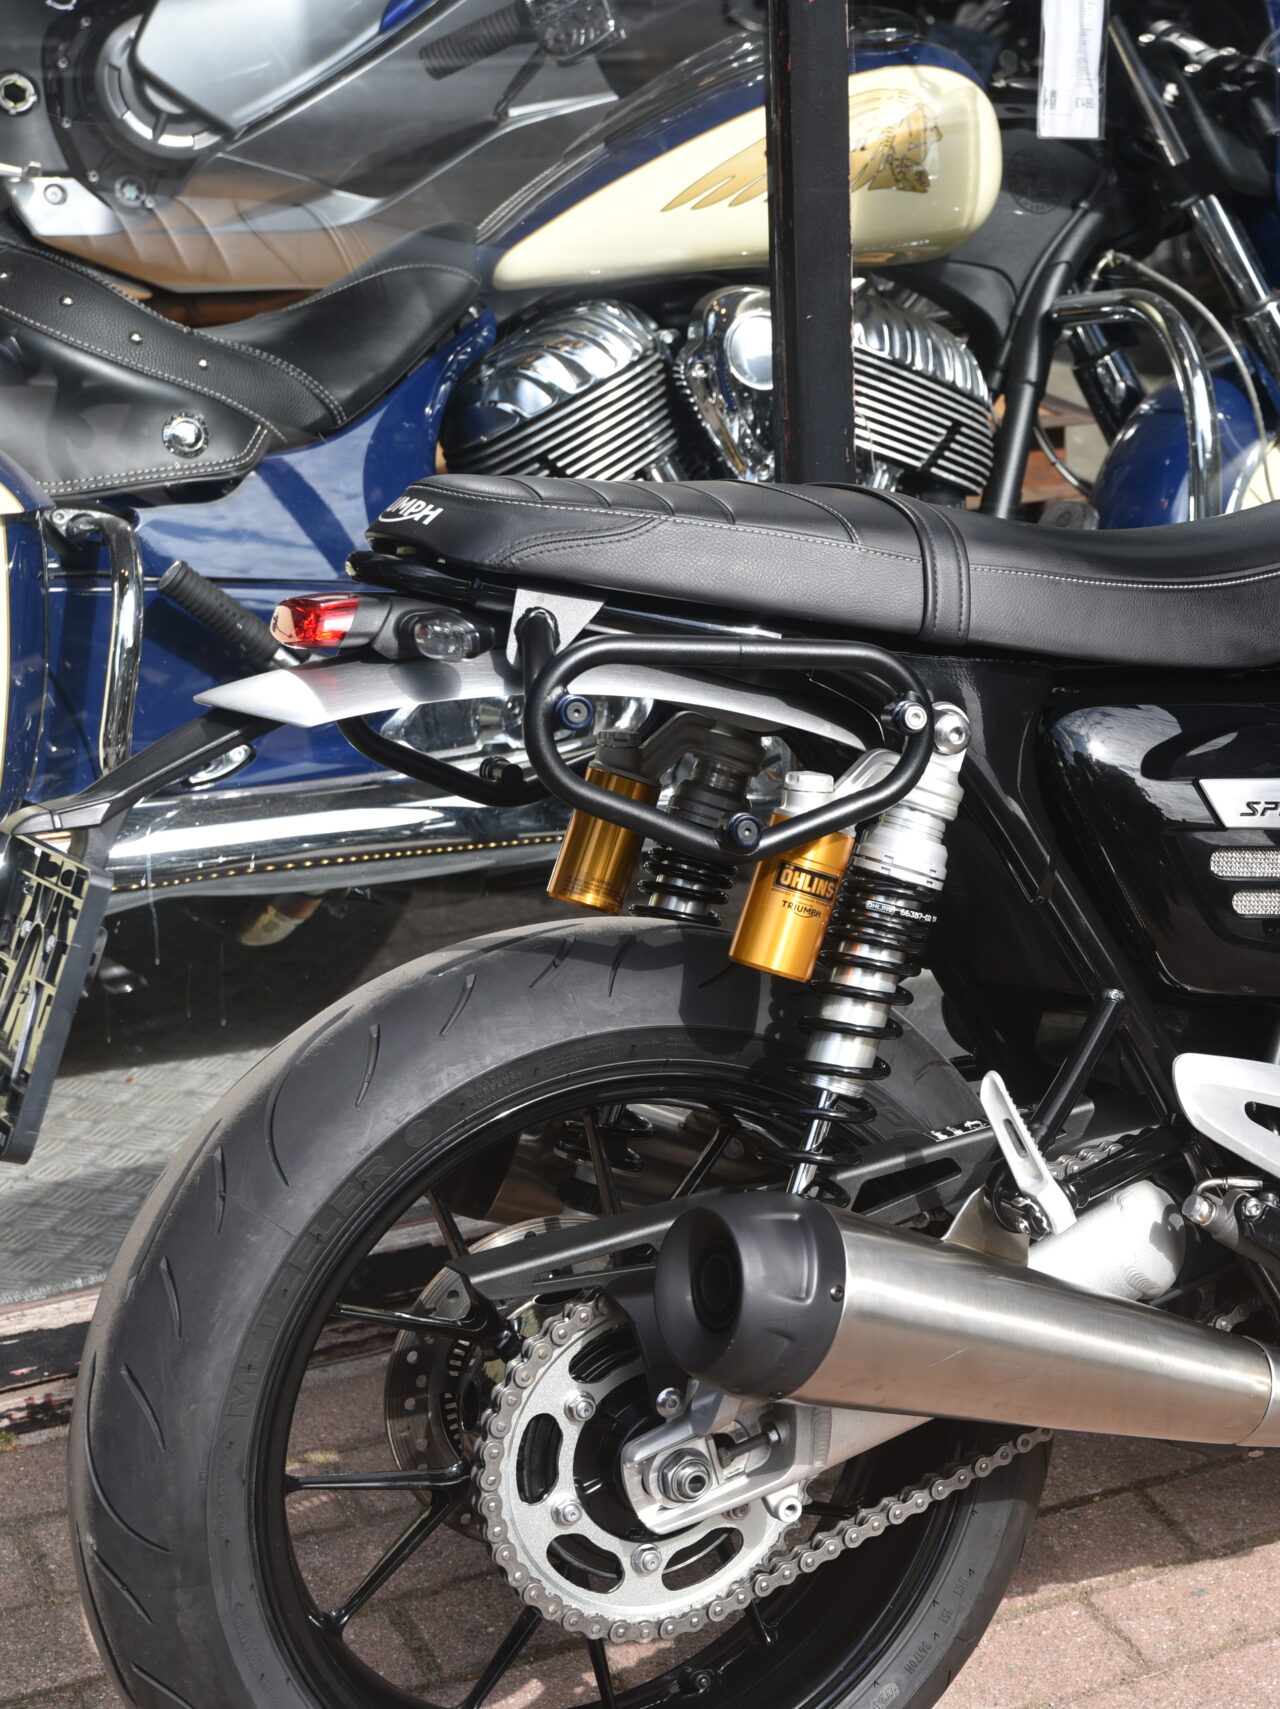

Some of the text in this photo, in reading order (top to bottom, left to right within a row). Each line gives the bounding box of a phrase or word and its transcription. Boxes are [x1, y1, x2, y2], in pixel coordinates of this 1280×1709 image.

[779, 863, 836, 899] ÖHLINS
[782, 900, 822, 919] TRIUMPH
[224, 1153, 392, 1419] METZELER
